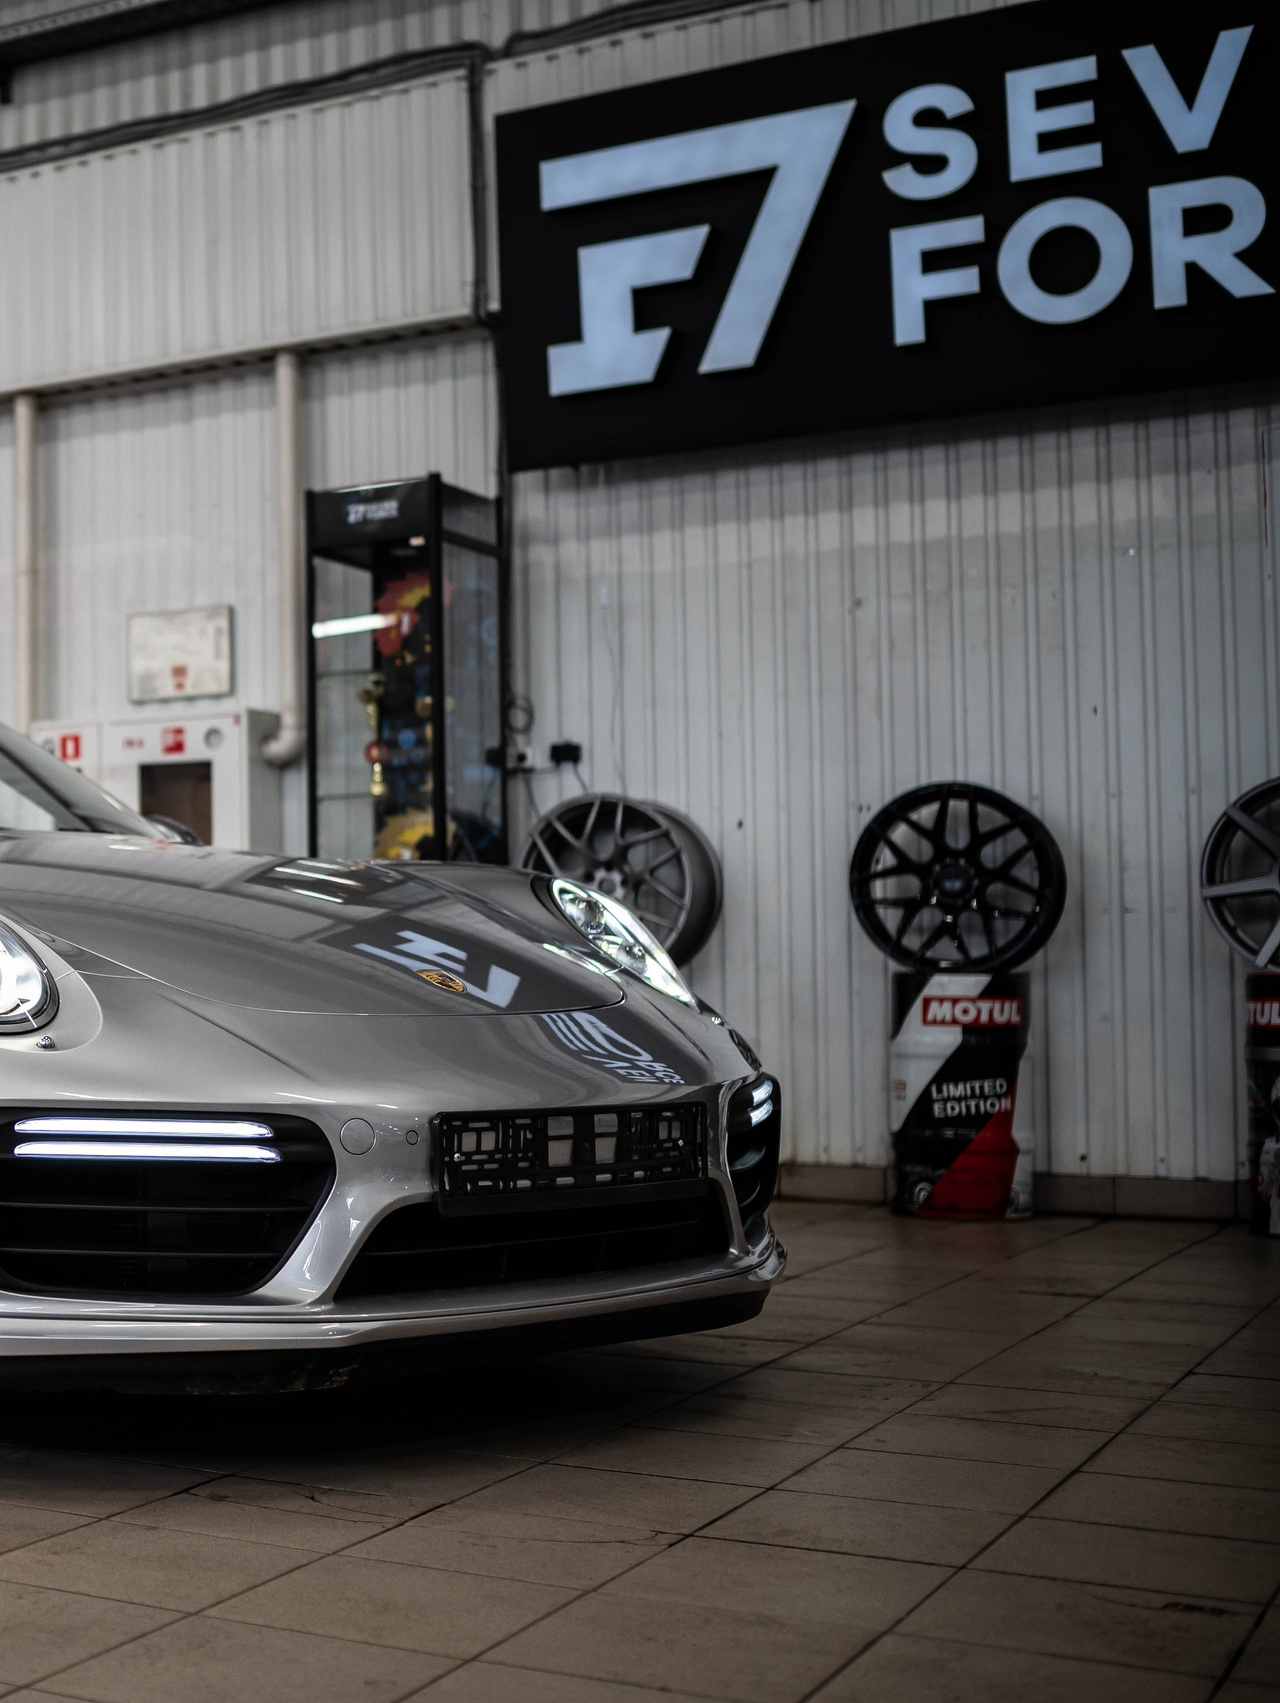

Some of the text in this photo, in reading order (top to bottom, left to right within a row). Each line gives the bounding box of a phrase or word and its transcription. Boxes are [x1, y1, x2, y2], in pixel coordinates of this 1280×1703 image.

[881, 25, 1254, 201] SEV
[889, 175, 1276, 347] FOR
[926, 999, 1021, 1025] MOTUL
[931, 1077, 1007, 1101] LIMITED
[933, 1095, 1012, 1118] EDITION
